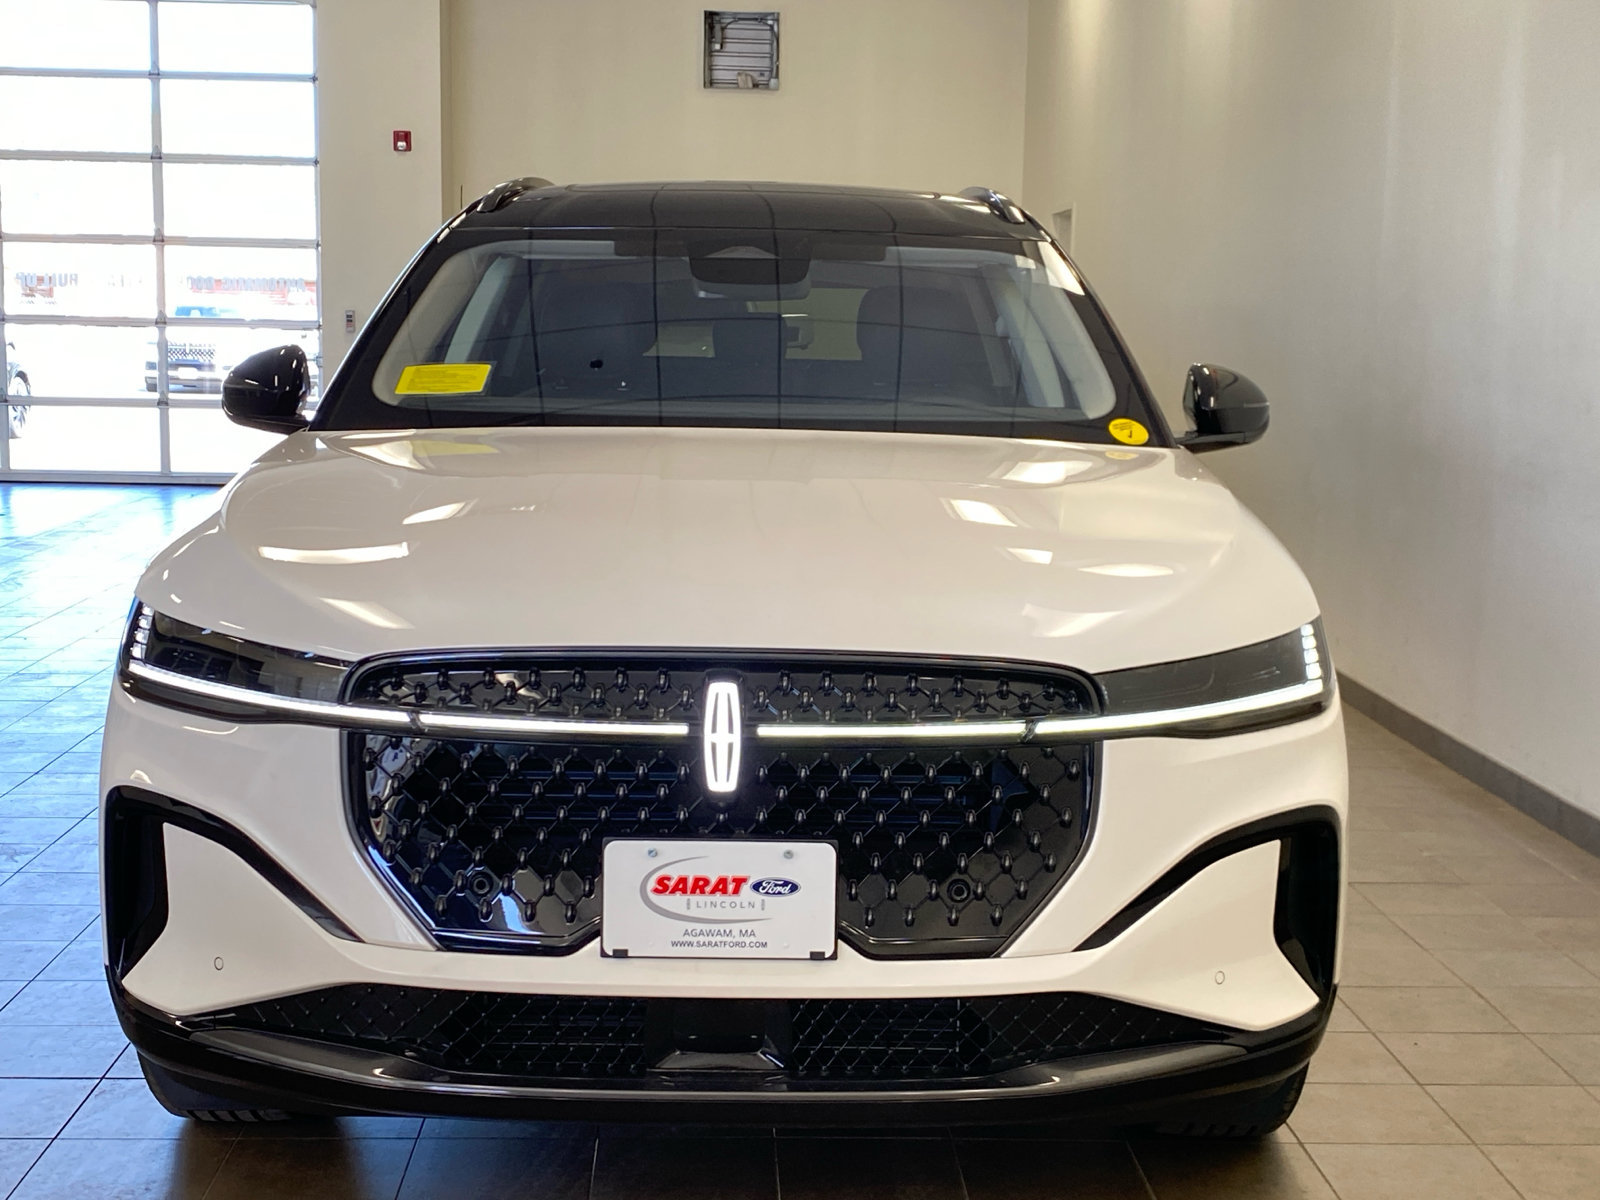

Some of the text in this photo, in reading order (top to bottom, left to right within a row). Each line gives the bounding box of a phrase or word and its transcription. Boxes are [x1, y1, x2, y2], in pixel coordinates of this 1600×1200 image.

[651, 874, 749, 896] SARAT
[758, 879, 792, 895] Ford
[696, 900, 755, 909] LINCOLN
[682, 928, 757, 939] AGAWAM, MA
[671, 940, 768, 949] WWW.SARATFORD.COM
